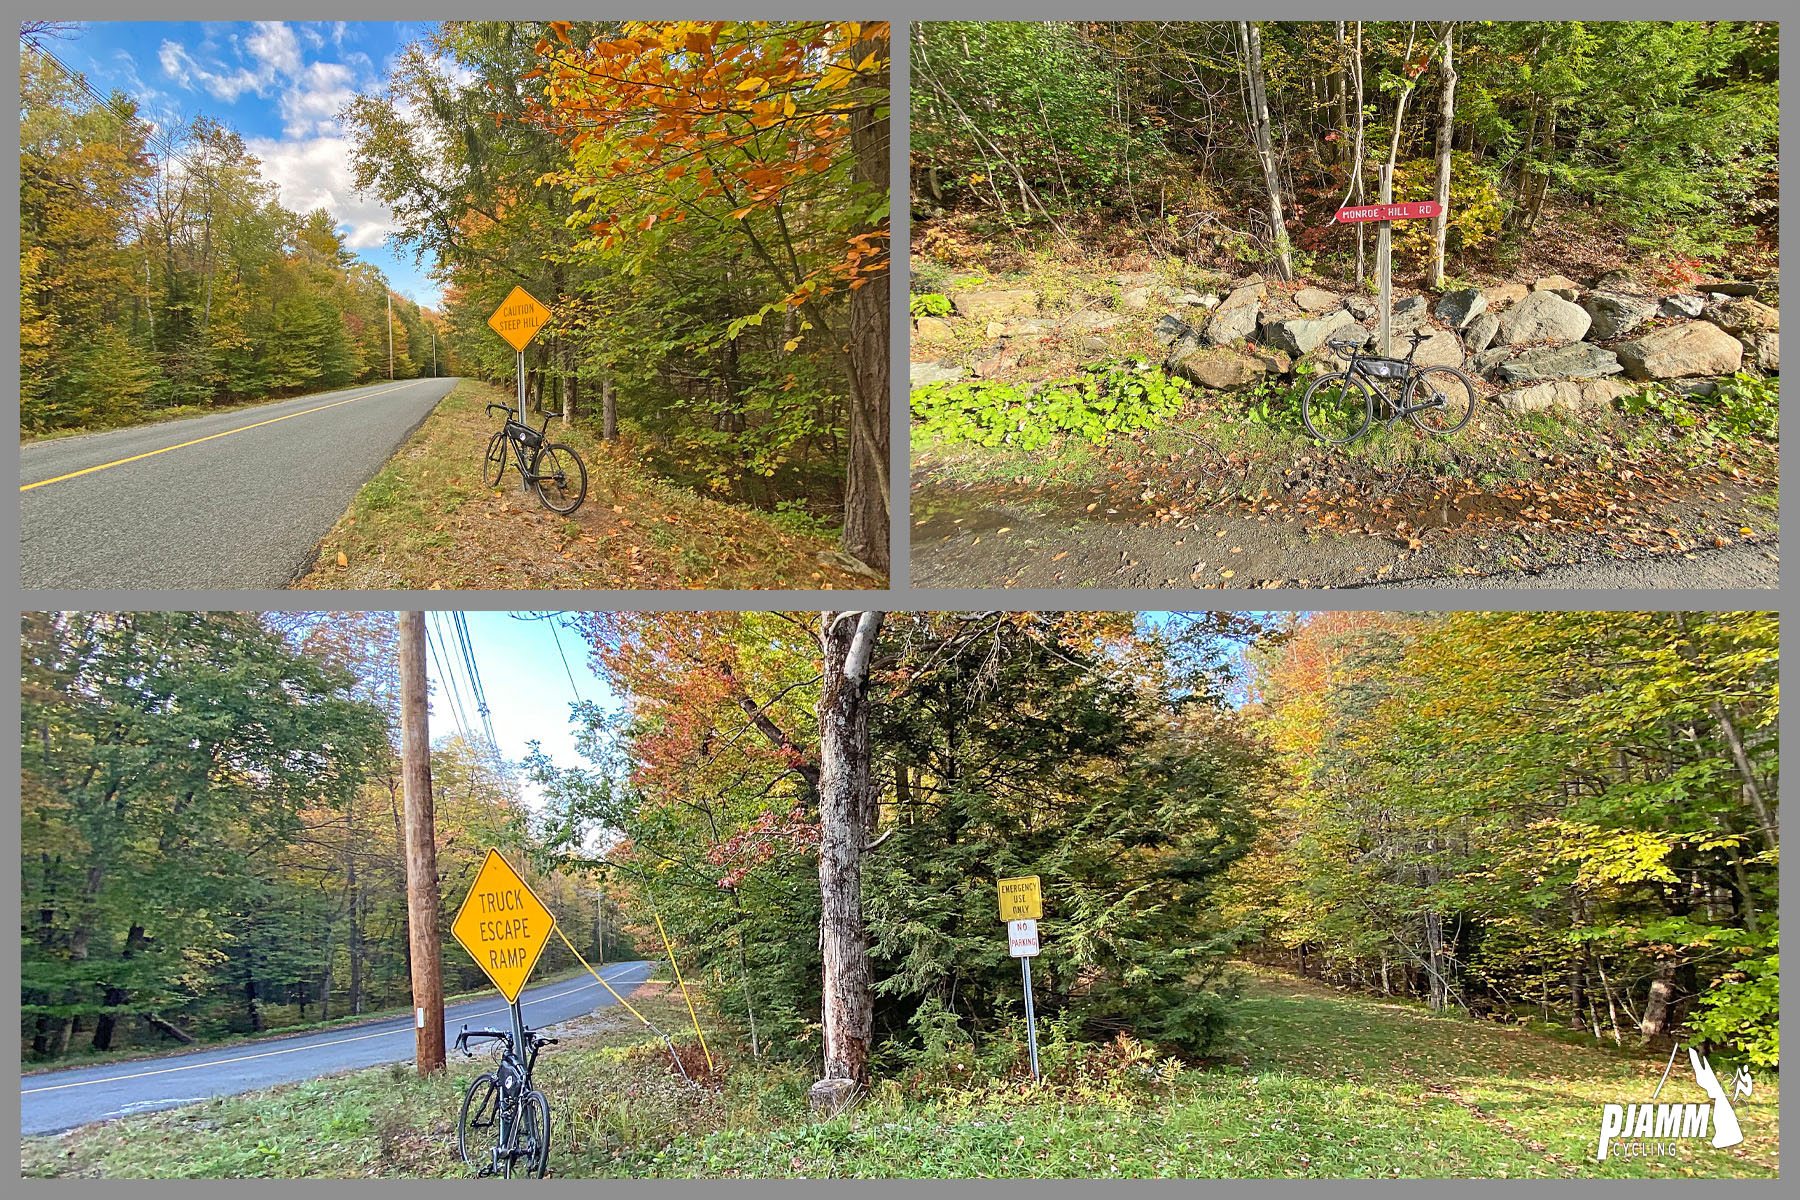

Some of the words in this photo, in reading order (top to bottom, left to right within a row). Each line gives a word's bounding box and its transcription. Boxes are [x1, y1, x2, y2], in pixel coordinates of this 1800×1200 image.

[1342, 208, 1379, 219] MONROE
[1388, 207, 1409, 216] HILL
[1419, 205, 1432, 215] RD
[503, 303, 534, 317] CAUTION
[499, 319, 521, 331] STEEP
[523, 316, 540, 328] HILL
[1001, 882, 1037, 894] EMERGENCY
[479, 889, 524, 913] TRUCK
[1013, 894, 1025, 904] USE
[1012, 905, 1030, 915] ONLY
[480, 918, 531, 942] ESCAPE
[1017, 922, 1028, 931] NO
[1011, 937, 1036, 947] PARKING
[489, 947, 527, 969] RAMP
